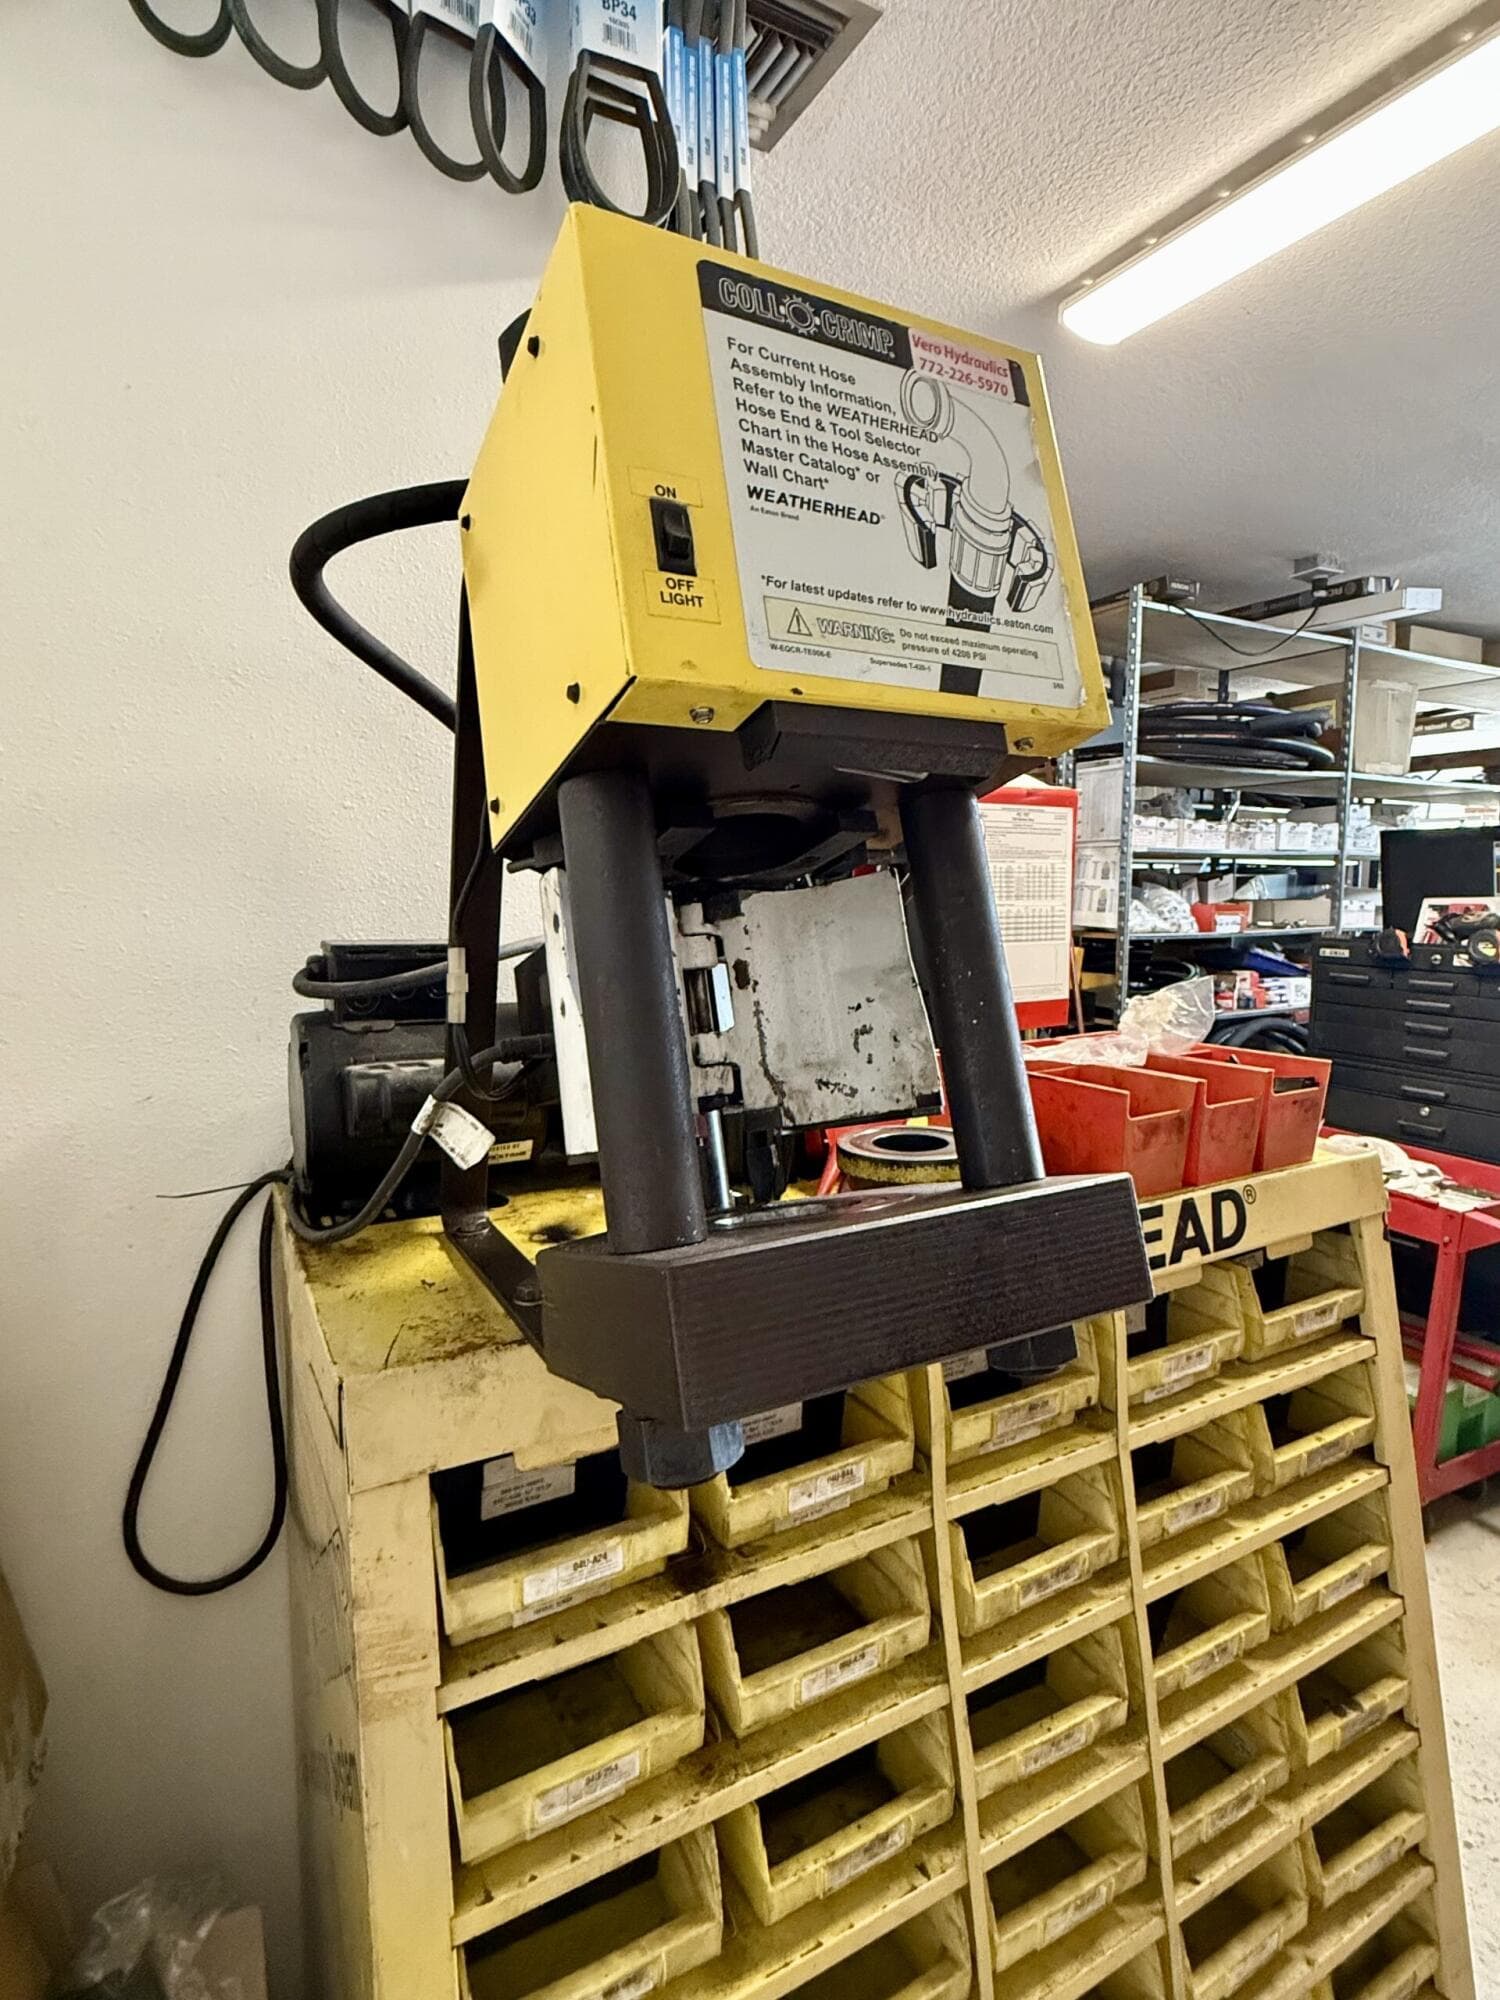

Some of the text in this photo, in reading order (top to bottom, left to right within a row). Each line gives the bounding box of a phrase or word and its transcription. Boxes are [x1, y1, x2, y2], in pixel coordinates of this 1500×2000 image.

[727, 336, 856, 385] For Current Hose
[912, 334, 1009, 378] Vero Hydraulics
[730, 358, 896, 416] Assembly Information,
[733, 377, 775, 400] Refer
[779, 390, 794, 405] to
[799, 395, 822, 413] the
[919, 357, 1008, 397] 772-226-5970
[736, 397, 921, 457] Hose End & Tool Selector
[738, 418, 940, 481] Chart in the Hose Assembly
[741, 438, 793, 463] Master
[865, 471, 880, 483] or
[743, 458, 778, 479] Wall
[654, 484, 677, 499] ON
[747, 485, 881, 525] WEATHERHEAD
[660, 590, 704, 609] LIGHT
[665, 577, 695, 593] OFF
[790, 580, 825, 596] latest
[828, 588, 874, 605] updates
[877, 597, 903, 609] refer
[906, 601, 917, 612] to
[920, 604, 1054, 634] www.hydraulics.eaton.com
[816, 617, 1039, 659] WARNING: Do not exceed maximum operating
[902, 642, 940, 655] pressure
[941, 647, 950, 656] of
[973, 651, 987, 661] PSI
